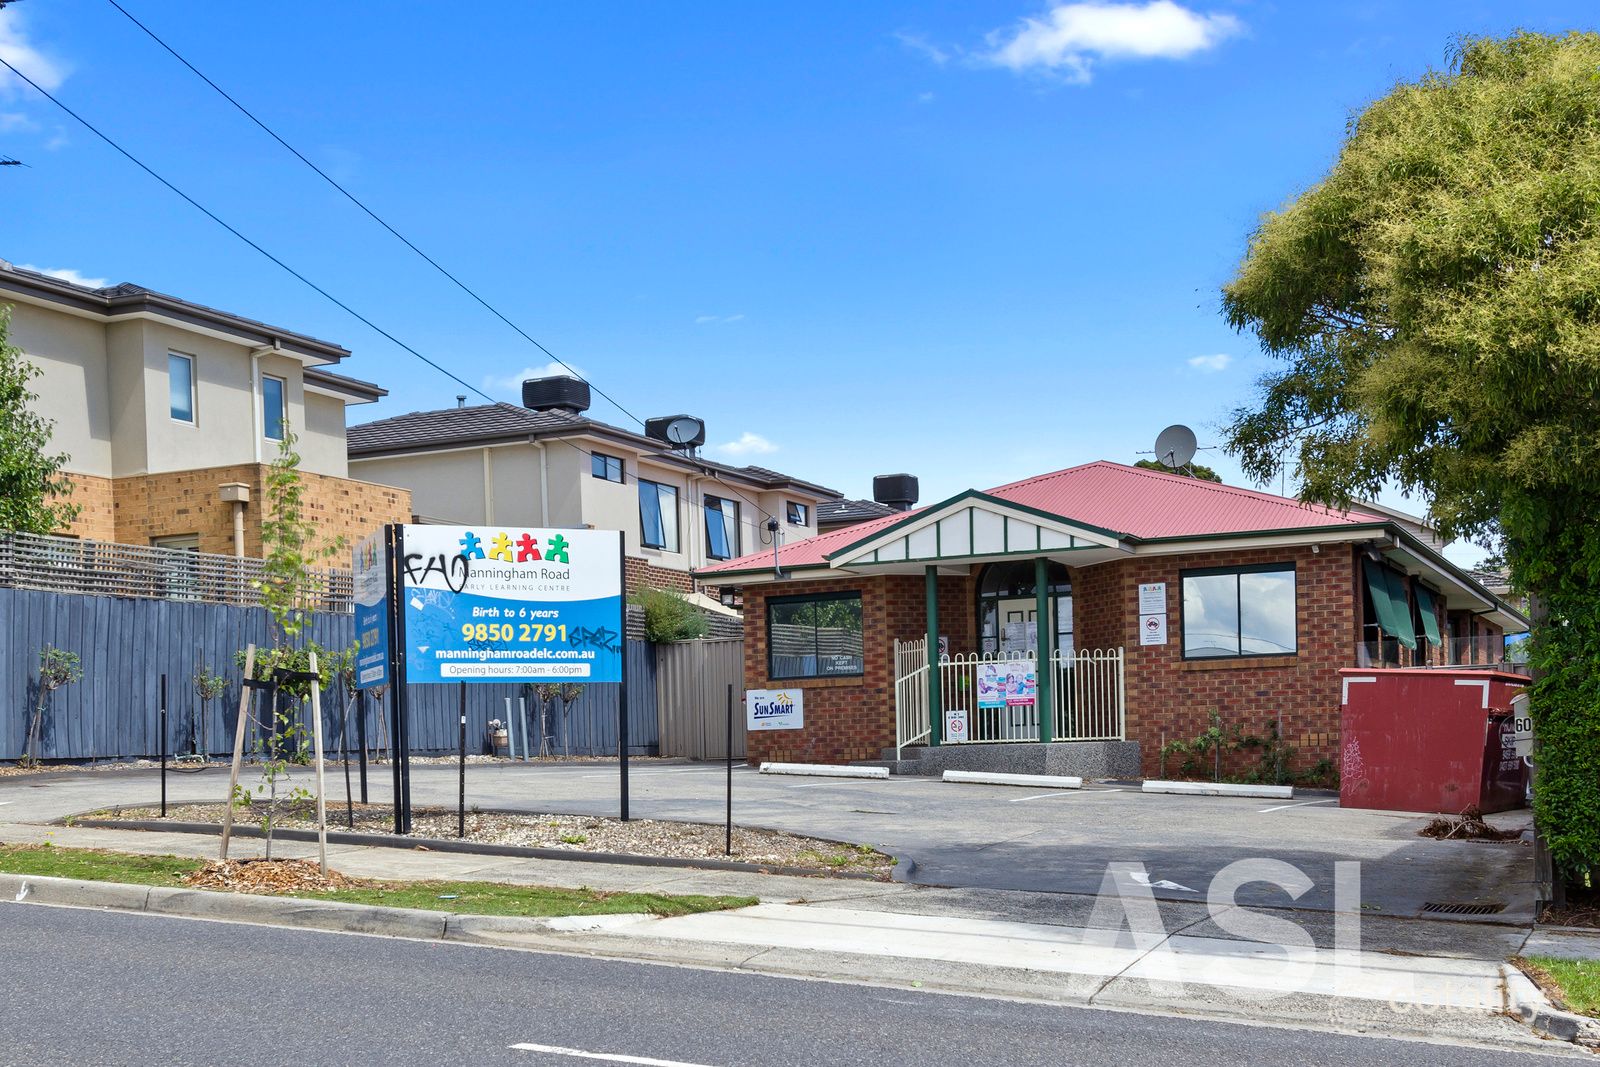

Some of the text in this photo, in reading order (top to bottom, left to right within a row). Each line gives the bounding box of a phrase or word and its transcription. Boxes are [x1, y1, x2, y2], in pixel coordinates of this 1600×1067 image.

[458, 566, 570, 581] Manningham Road
[459, 583, 485, 591] EARLY
[472, 606, 559, 621] Birth to 6 years
[461, 623, 567, 642] 9850 2791
[435, 648, 595, 661] manninghamroadelc.com.au
[449, 665, 486, 674] Opening
[488, 665, 514, 673] hours:
[515, 665, 546, 673] 7:00am
[551, 665, 582, 674] 6:00pm
[1515, 718, 1531, 732] 60
